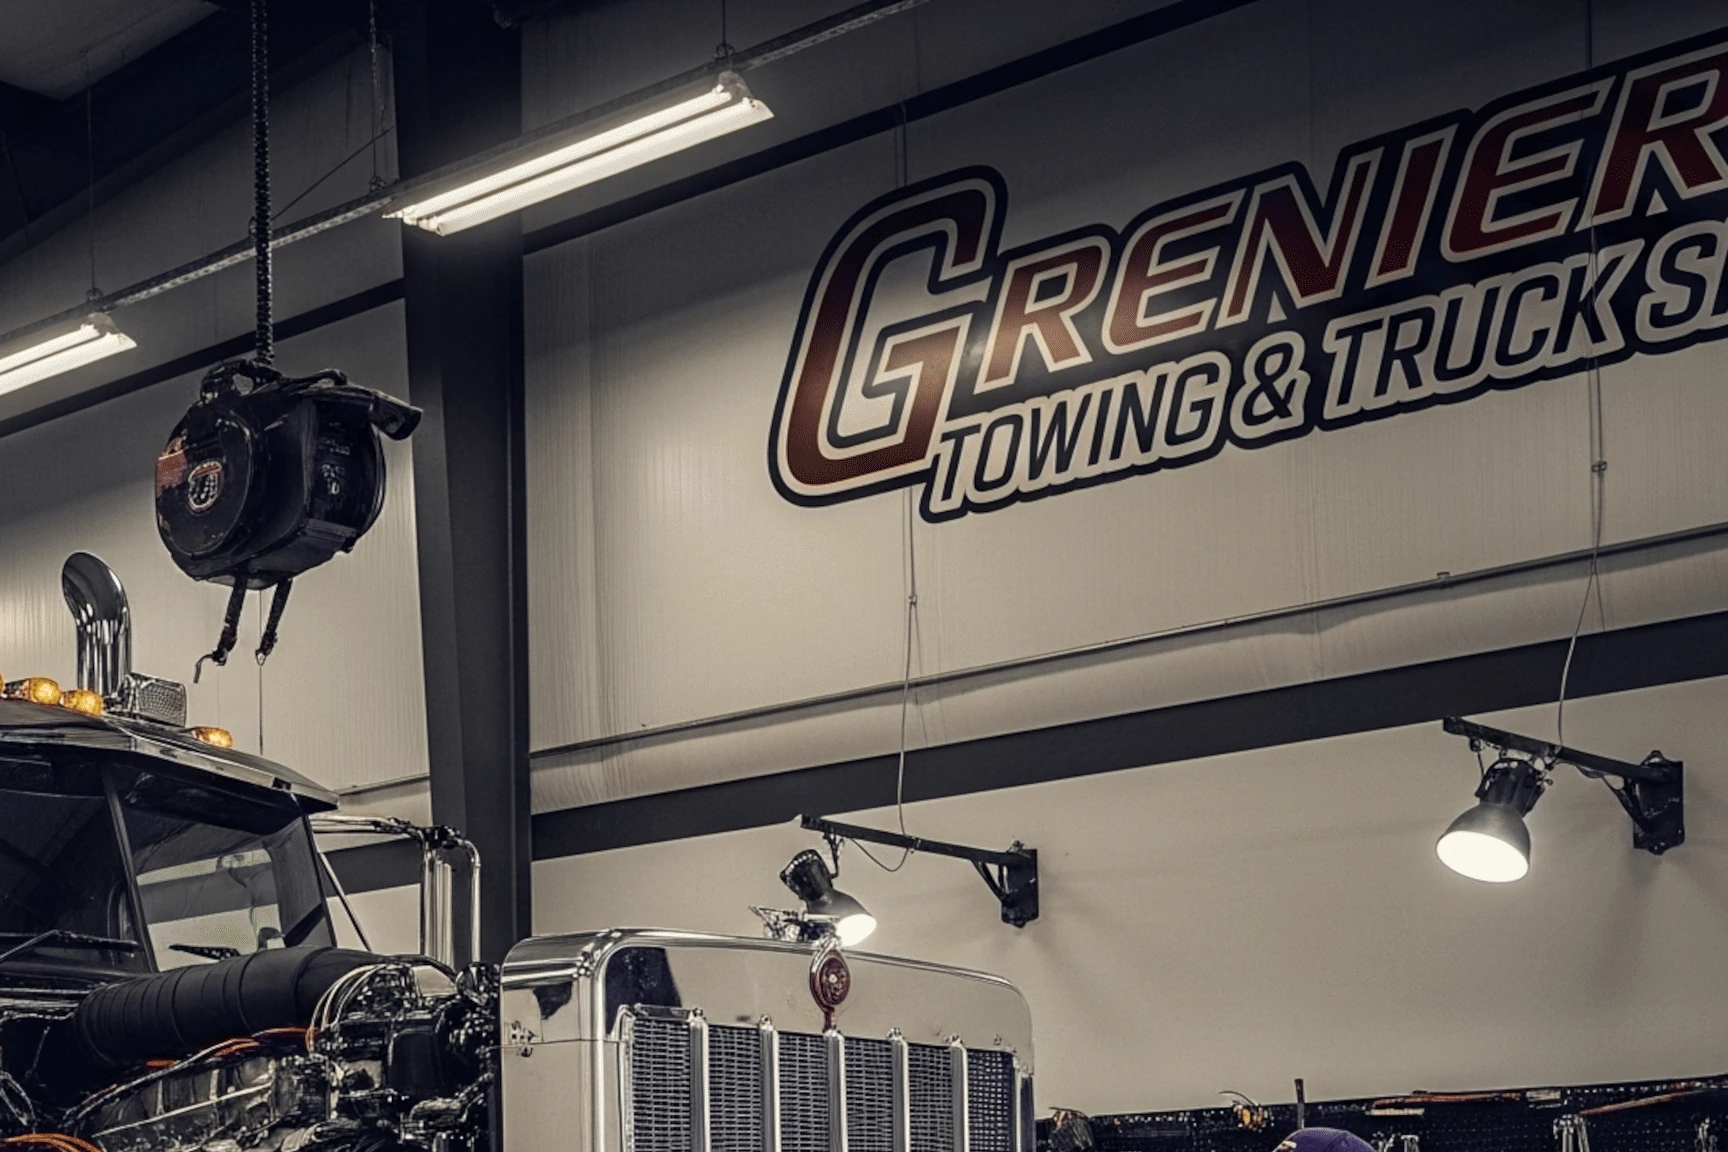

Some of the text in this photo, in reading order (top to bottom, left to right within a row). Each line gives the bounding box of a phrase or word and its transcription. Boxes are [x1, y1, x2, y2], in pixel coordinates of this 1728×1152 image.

[927, 218, 1728, 512] TOWING & TRUCK S
